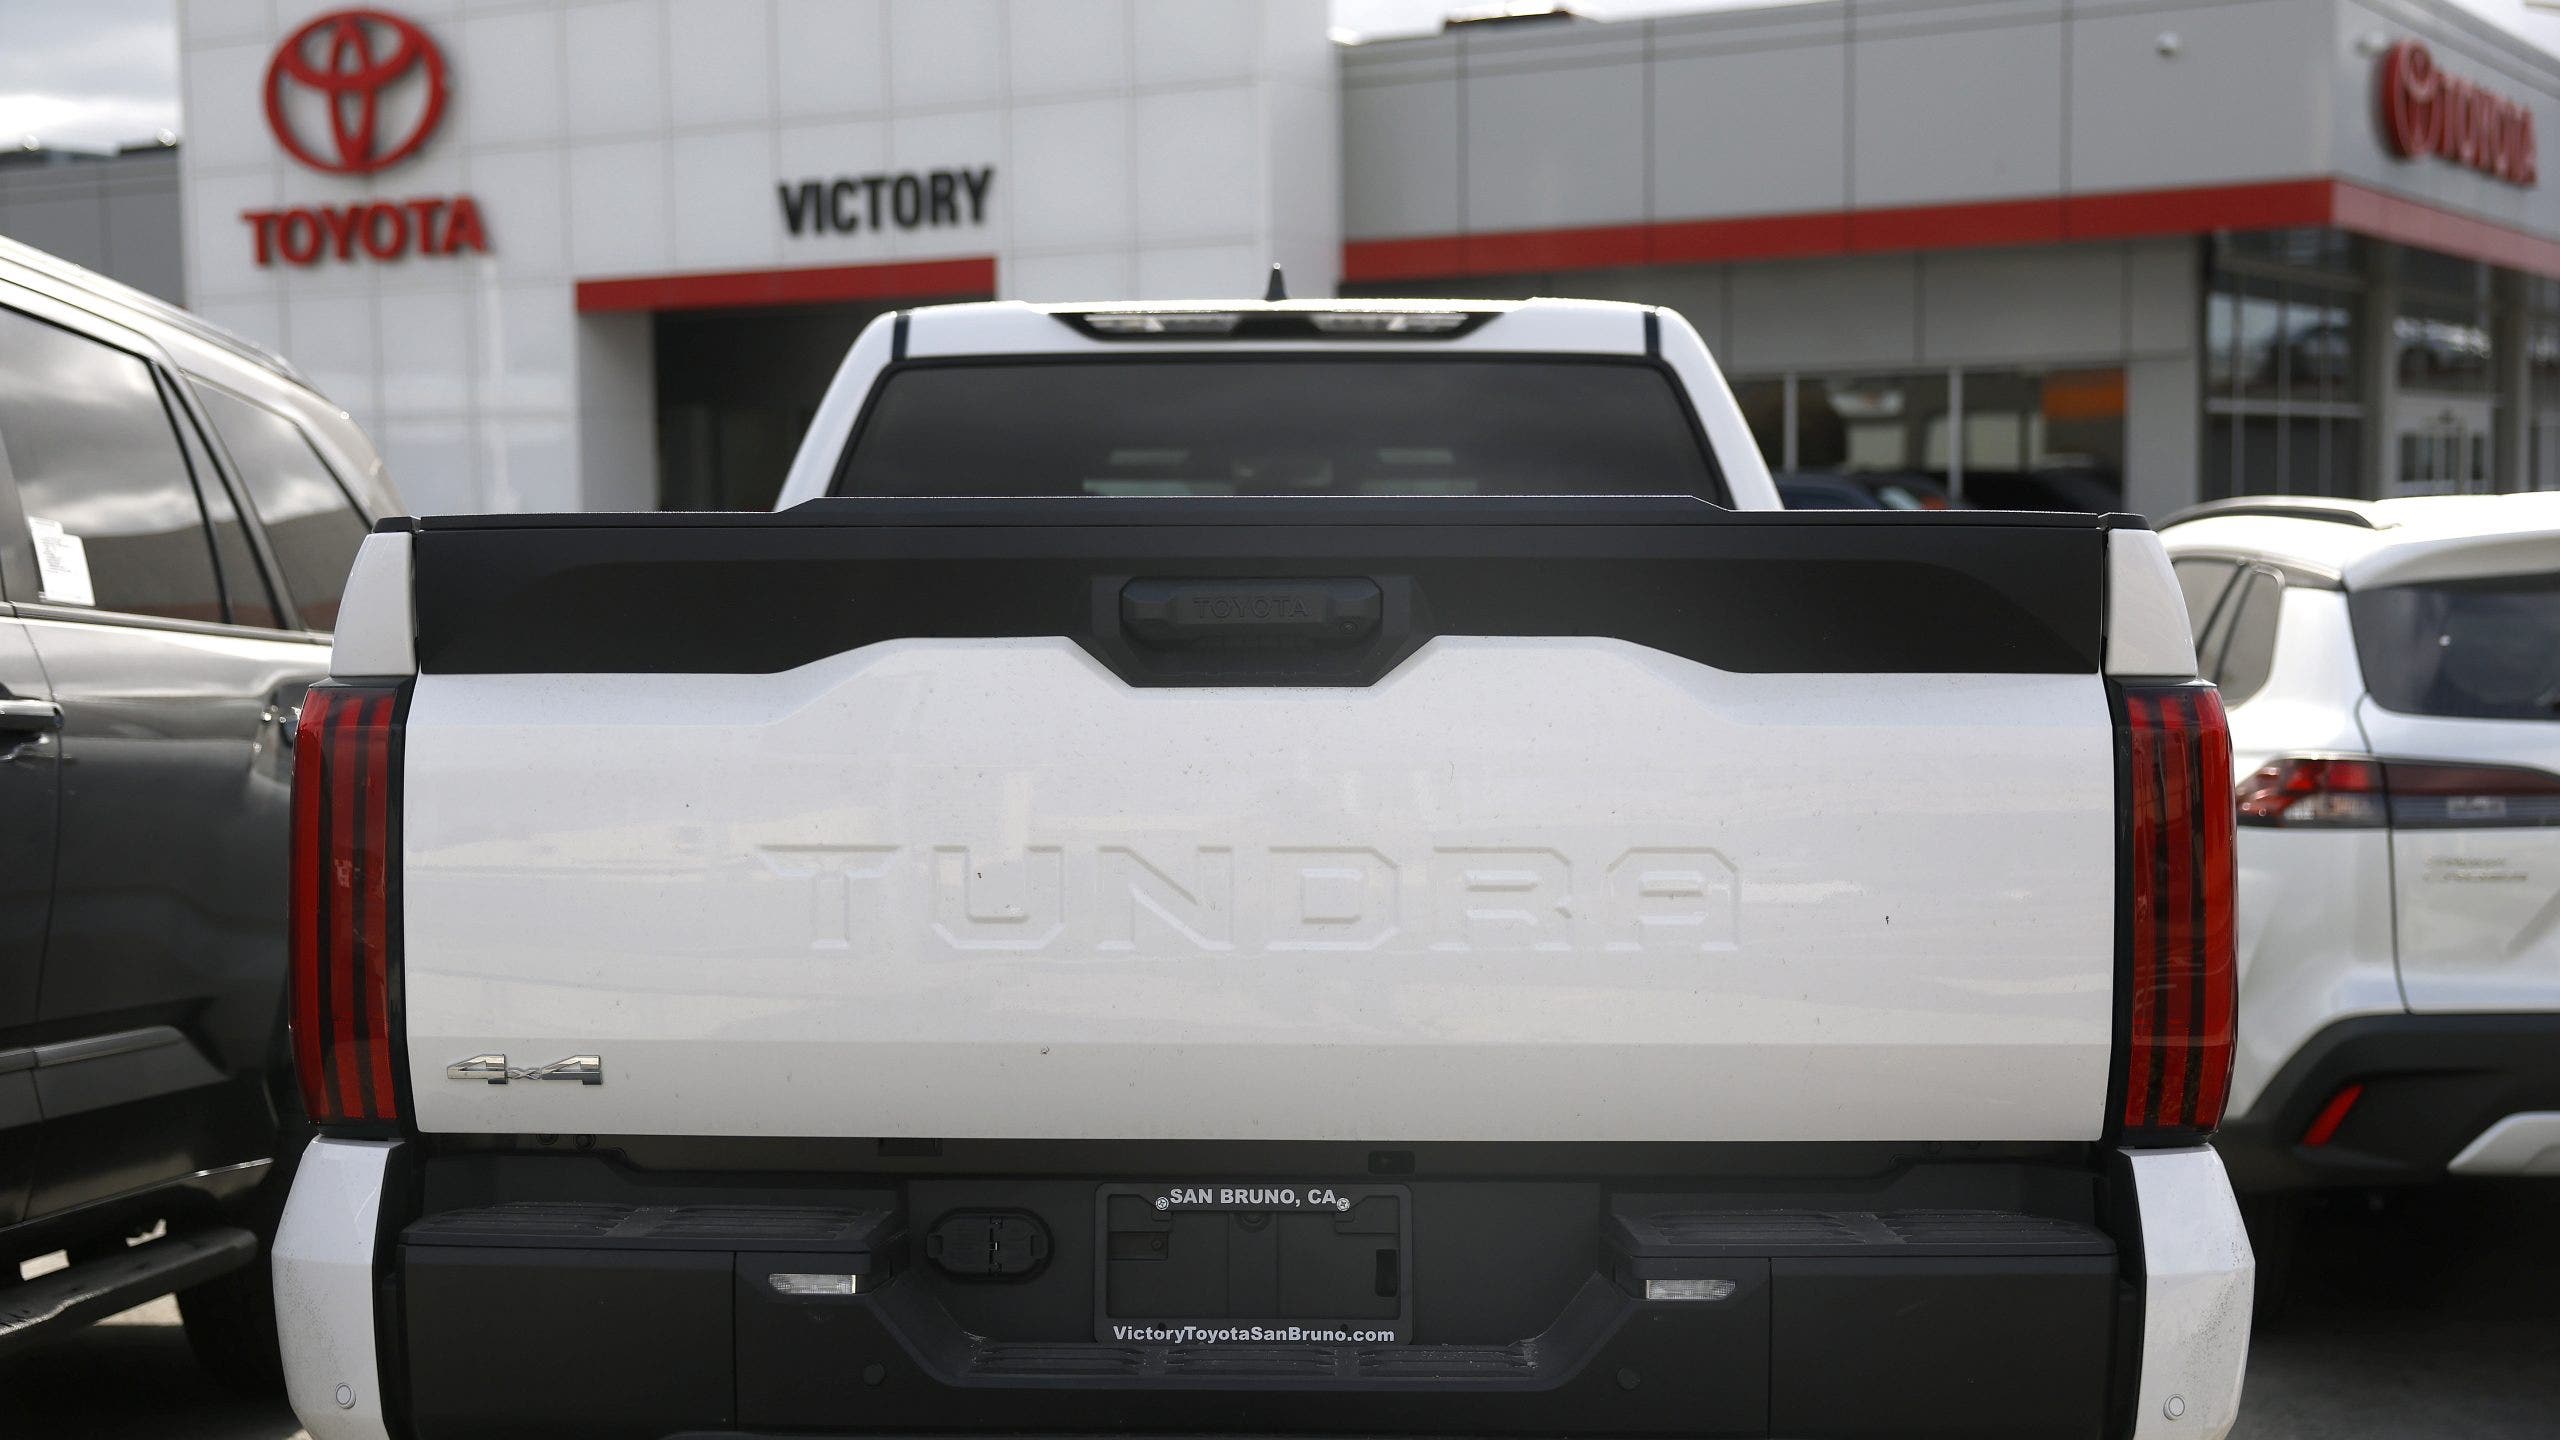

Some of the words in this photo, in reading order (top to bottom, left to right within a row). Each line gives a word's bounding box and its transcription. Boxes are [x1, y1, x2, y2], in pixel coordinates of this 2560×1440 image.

[777, 164, 994, 238] VICTORY
[241, 192, 491, 268] TOYOTA
[1193, 597, 1309, 618] TOYOTA
[756, 844, 1740, 953] TUNDRA
[1170, 1188, 1213, 1204] SAN
[1220, 1188, 1301, 1207] BRUNO,
[1307, 1189, 1337, 1204] CA
[1113, 1325, 1396, 1344] VictoryToyotaSanBruno.com
